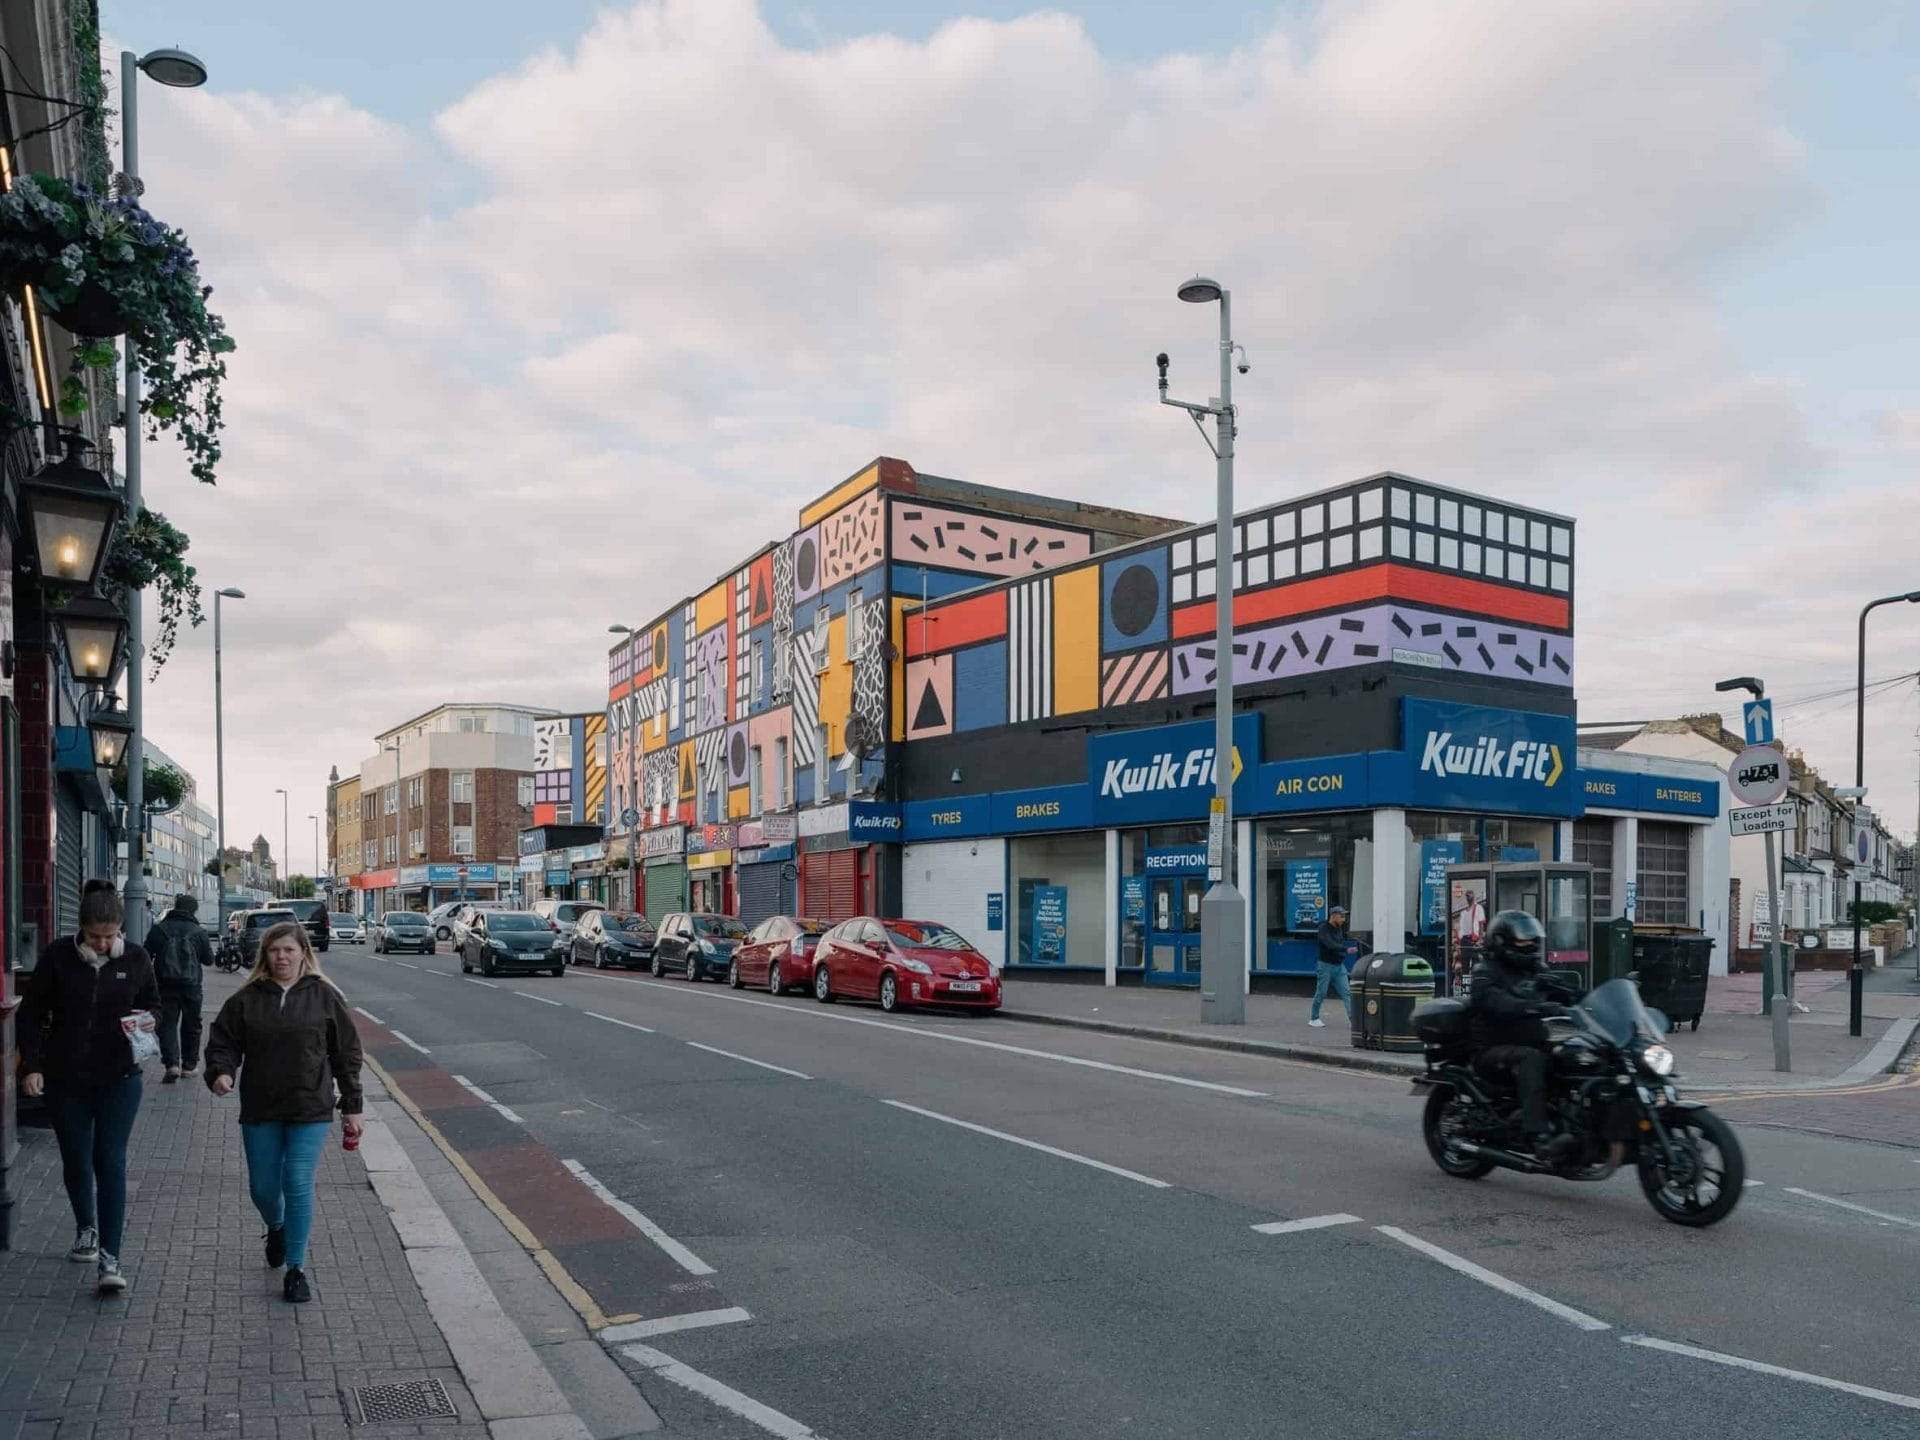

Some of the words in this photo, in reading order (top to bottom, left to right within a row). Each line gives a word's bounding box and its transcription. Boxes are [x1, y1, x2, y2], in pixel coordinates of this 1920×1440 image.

[1420, 730, 1505, 778] Kwik
[1505, 741, 1551, 782] Fit
[1100, 753, 1181, 798] Kwik
[1276, 779, 1302, 796] AIR
[1307, 775, 1343, 792] CON
[1585, 781, 1616, 795] RAKES
[1656, 788, 1702, 803] BATTERIES
[1016, 802, 1060, 818] BRAKES
[1732, 809, 1772, 821] Except
[1777, 807, 1793, 816] for
[931, 811, 962, 826] TYRES
[1743, 820, 1785, 831] loading
[1146, 854, 1206, 868] RECEPTION
